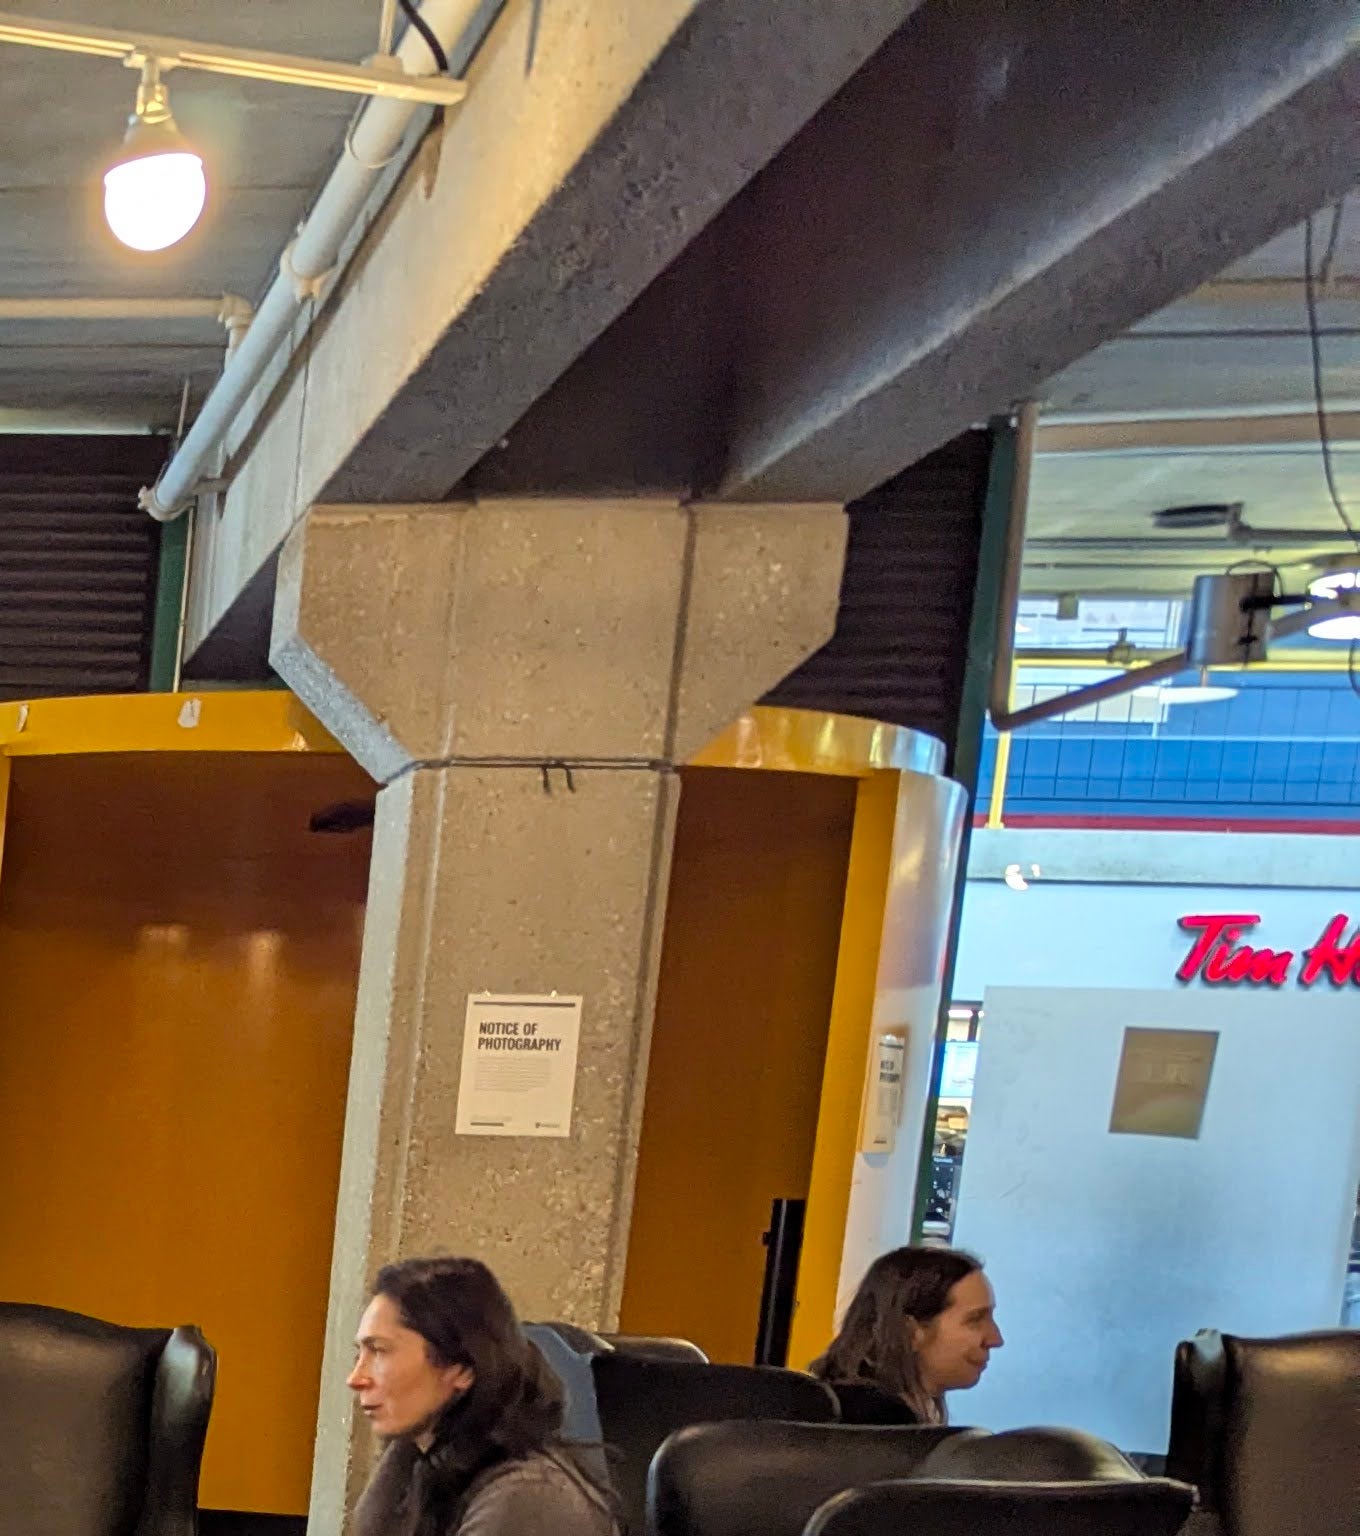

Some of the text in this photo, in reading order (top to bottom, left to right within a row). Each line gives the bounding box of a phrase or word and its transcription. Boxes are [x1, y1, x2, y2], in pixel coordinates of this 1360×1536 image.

[1175, 914, 1293, 986] Tim
[479, 1022, 538, 1036] NOTICE OF
[478, 1037, 561, 1051] PHOTOGRAPHY
